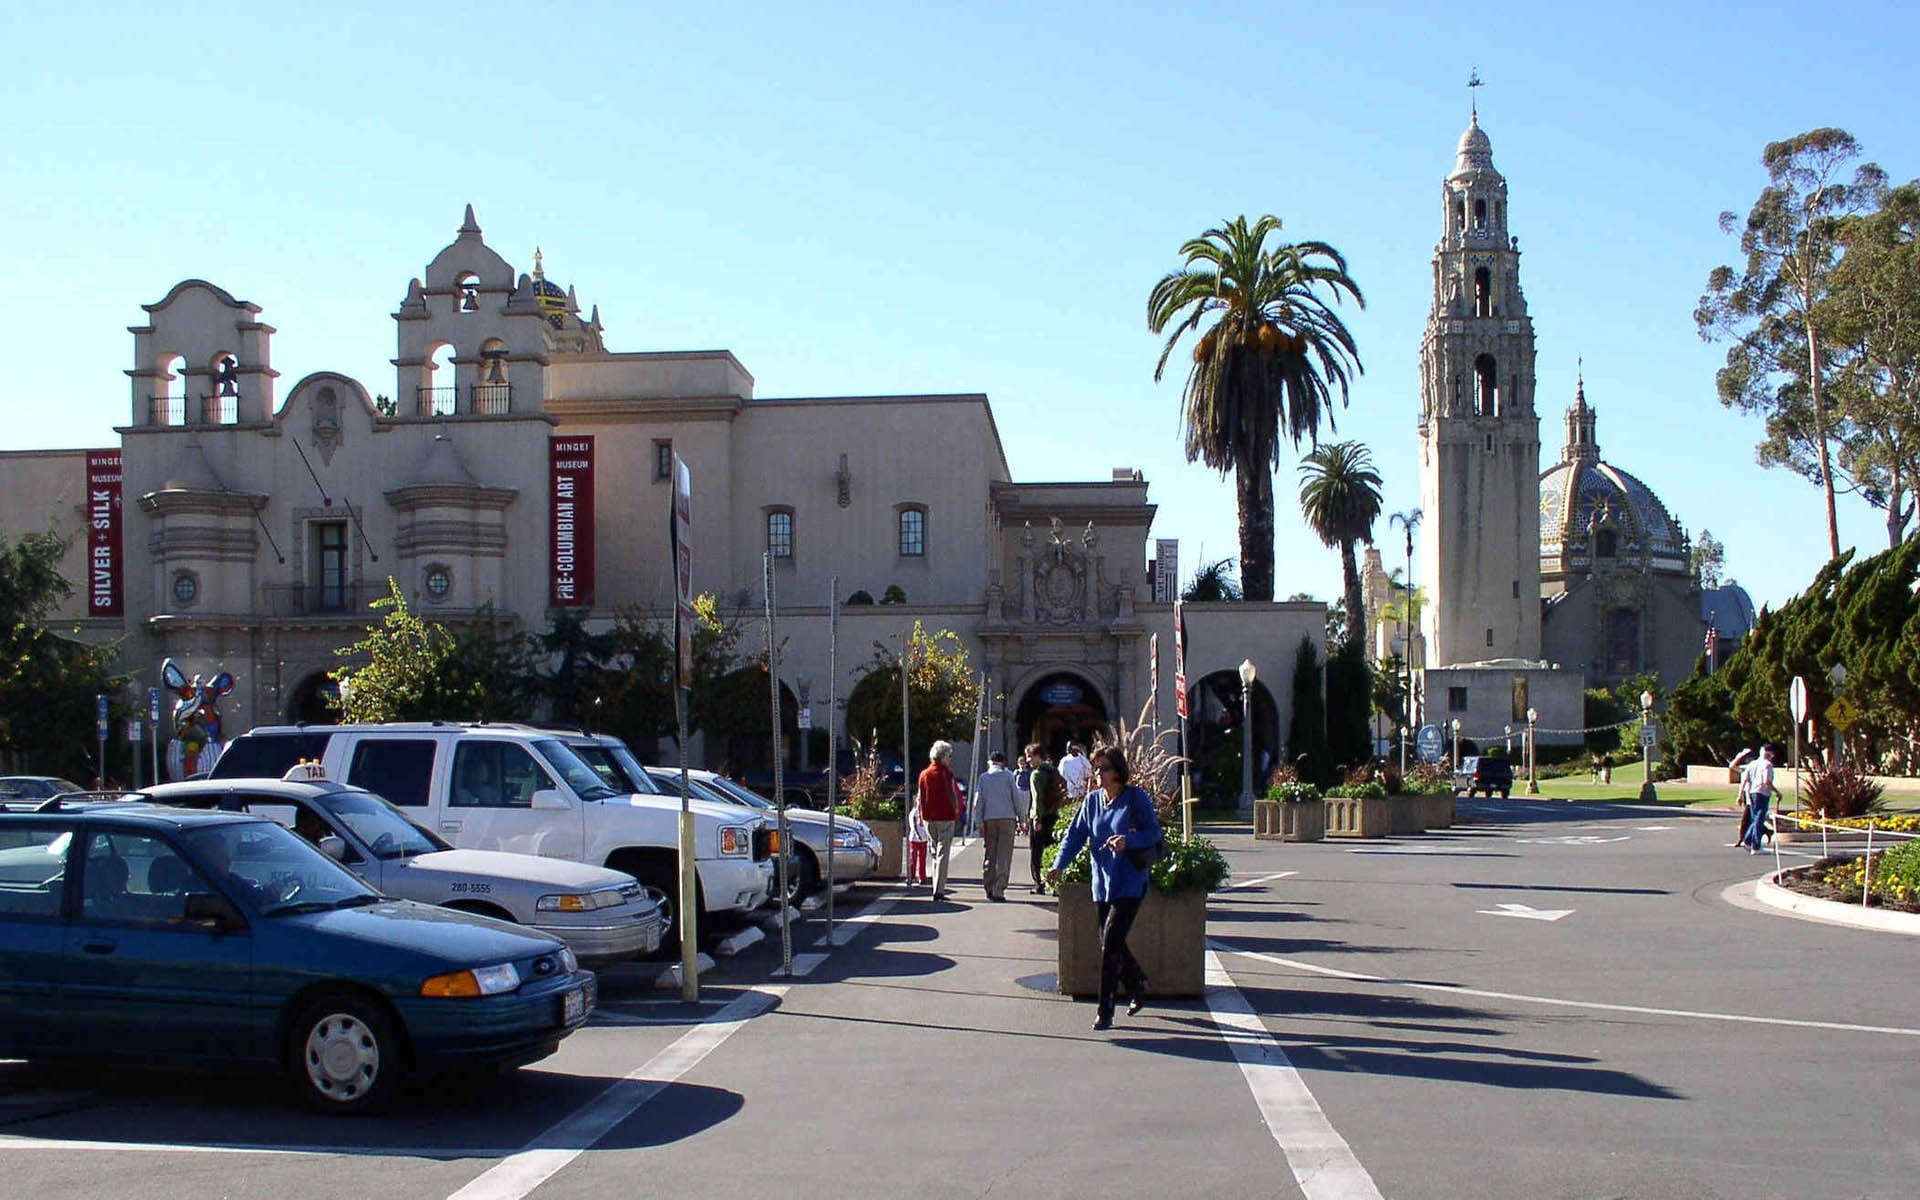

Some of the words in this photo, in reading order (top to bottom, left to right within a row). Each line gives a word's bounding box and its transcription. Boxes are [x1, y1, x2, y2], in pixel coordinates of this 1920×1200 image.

[556, 443, 589, 451] MINGEI
[556, 461, 589, 469] MUSEUM
[91, 475, 123, 483] MUSEUM
[557, 475, 574, 498] ART
[93, 490, 110, 529] SILK
[95, 546, 111, 606] SILVER
[305, 766, 326, 779] TAXI
